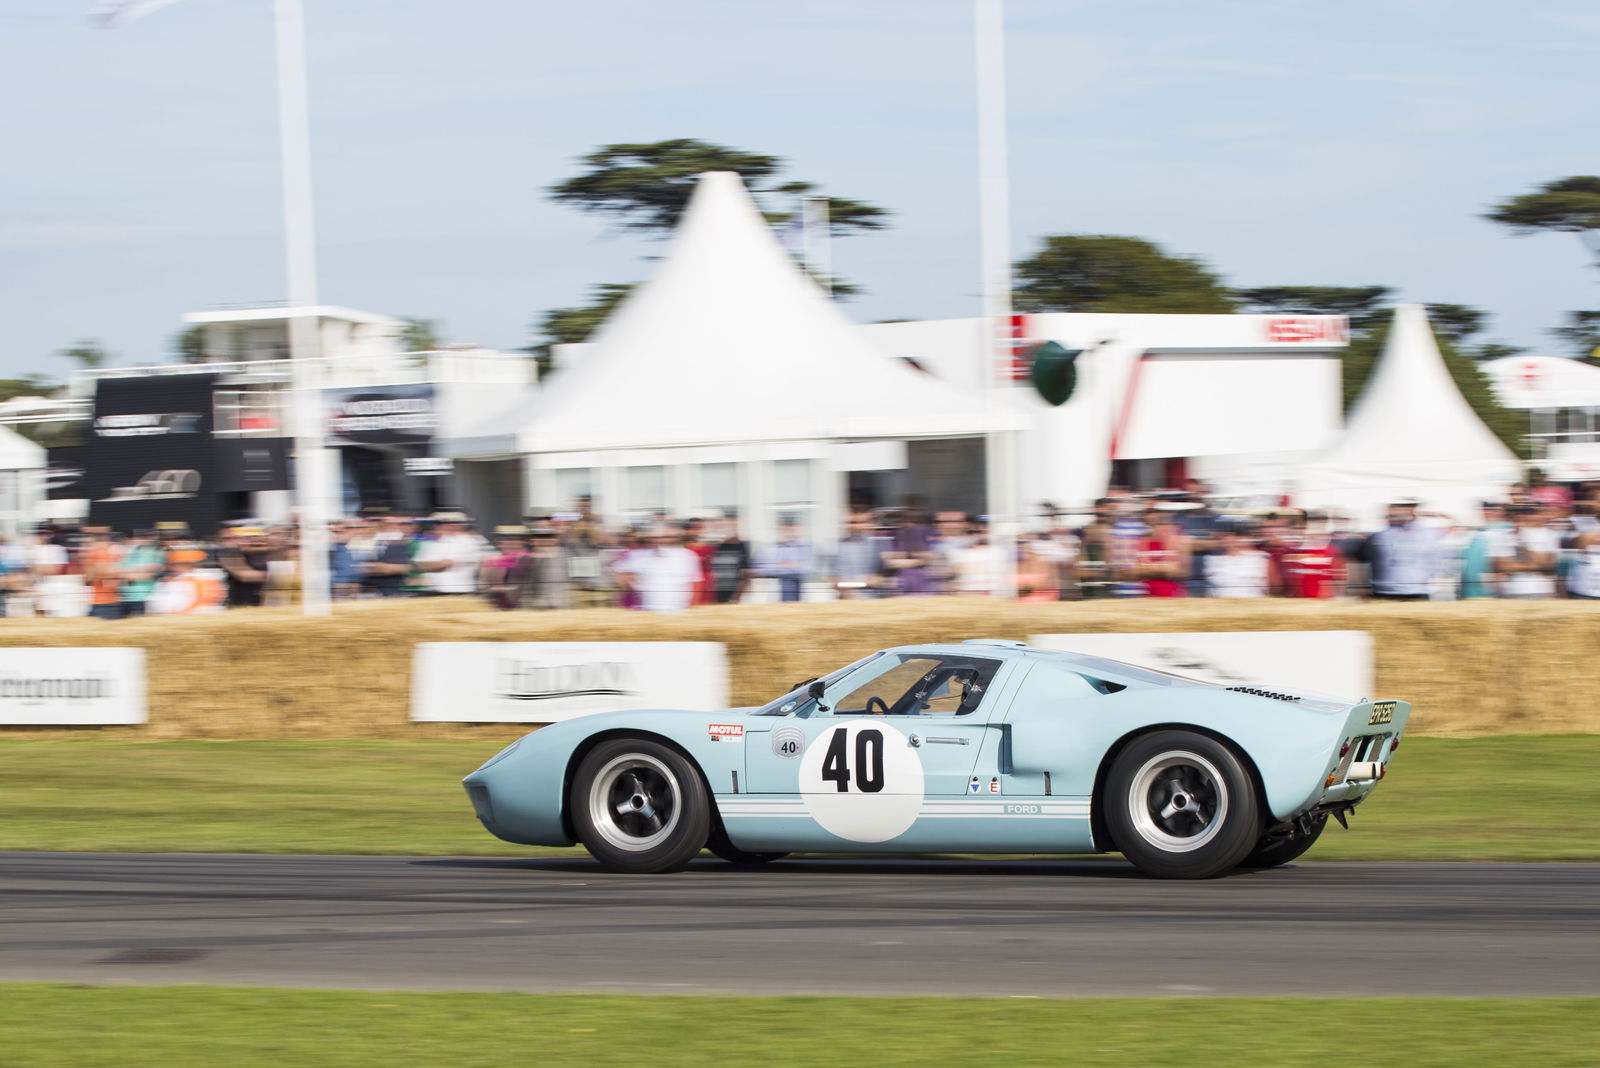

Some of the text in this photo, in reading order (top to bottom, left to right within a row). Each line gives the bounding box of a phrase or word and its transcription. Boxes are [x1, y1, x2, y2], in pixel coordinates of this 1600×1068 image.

[709, 725, 742, 734] MOTUL
[781, 741, 796, 753] 40
[822, 727, 885, 793] 40
[990, 782, 998, 793] E
[1007, 805, 1038, 814] FORD
